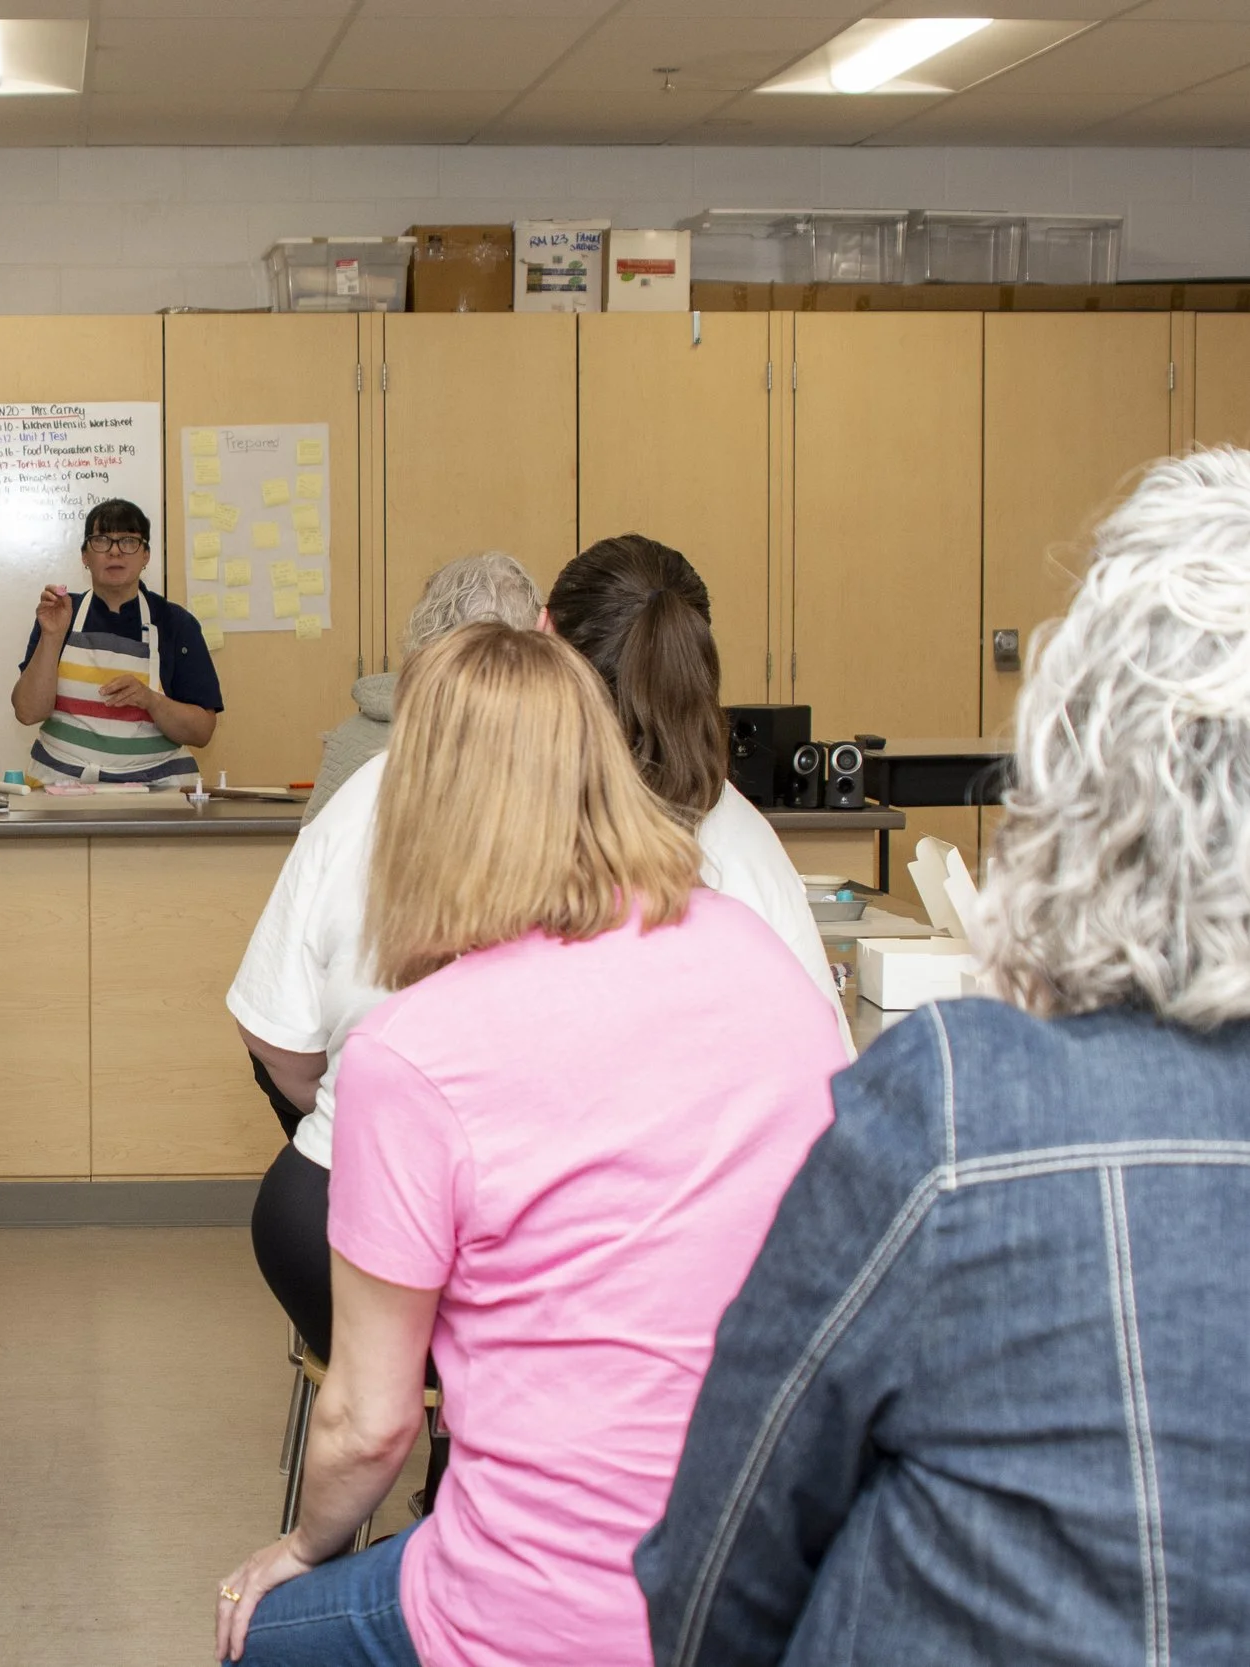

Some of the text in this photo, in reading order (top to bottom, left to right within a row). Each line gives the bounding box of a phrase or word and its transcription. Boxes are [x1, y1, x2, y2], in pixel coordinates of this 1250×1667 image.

[551, 234, 569, 246] 123
[4, 421, 14, 431] 10
[49, 431, 67, 441] Test
[23, 444, 42, 456] Food
[0, 461, 8, 470] 17
[62, 458, 91, 468] Chicken
[61, 470, 71, 480] of
